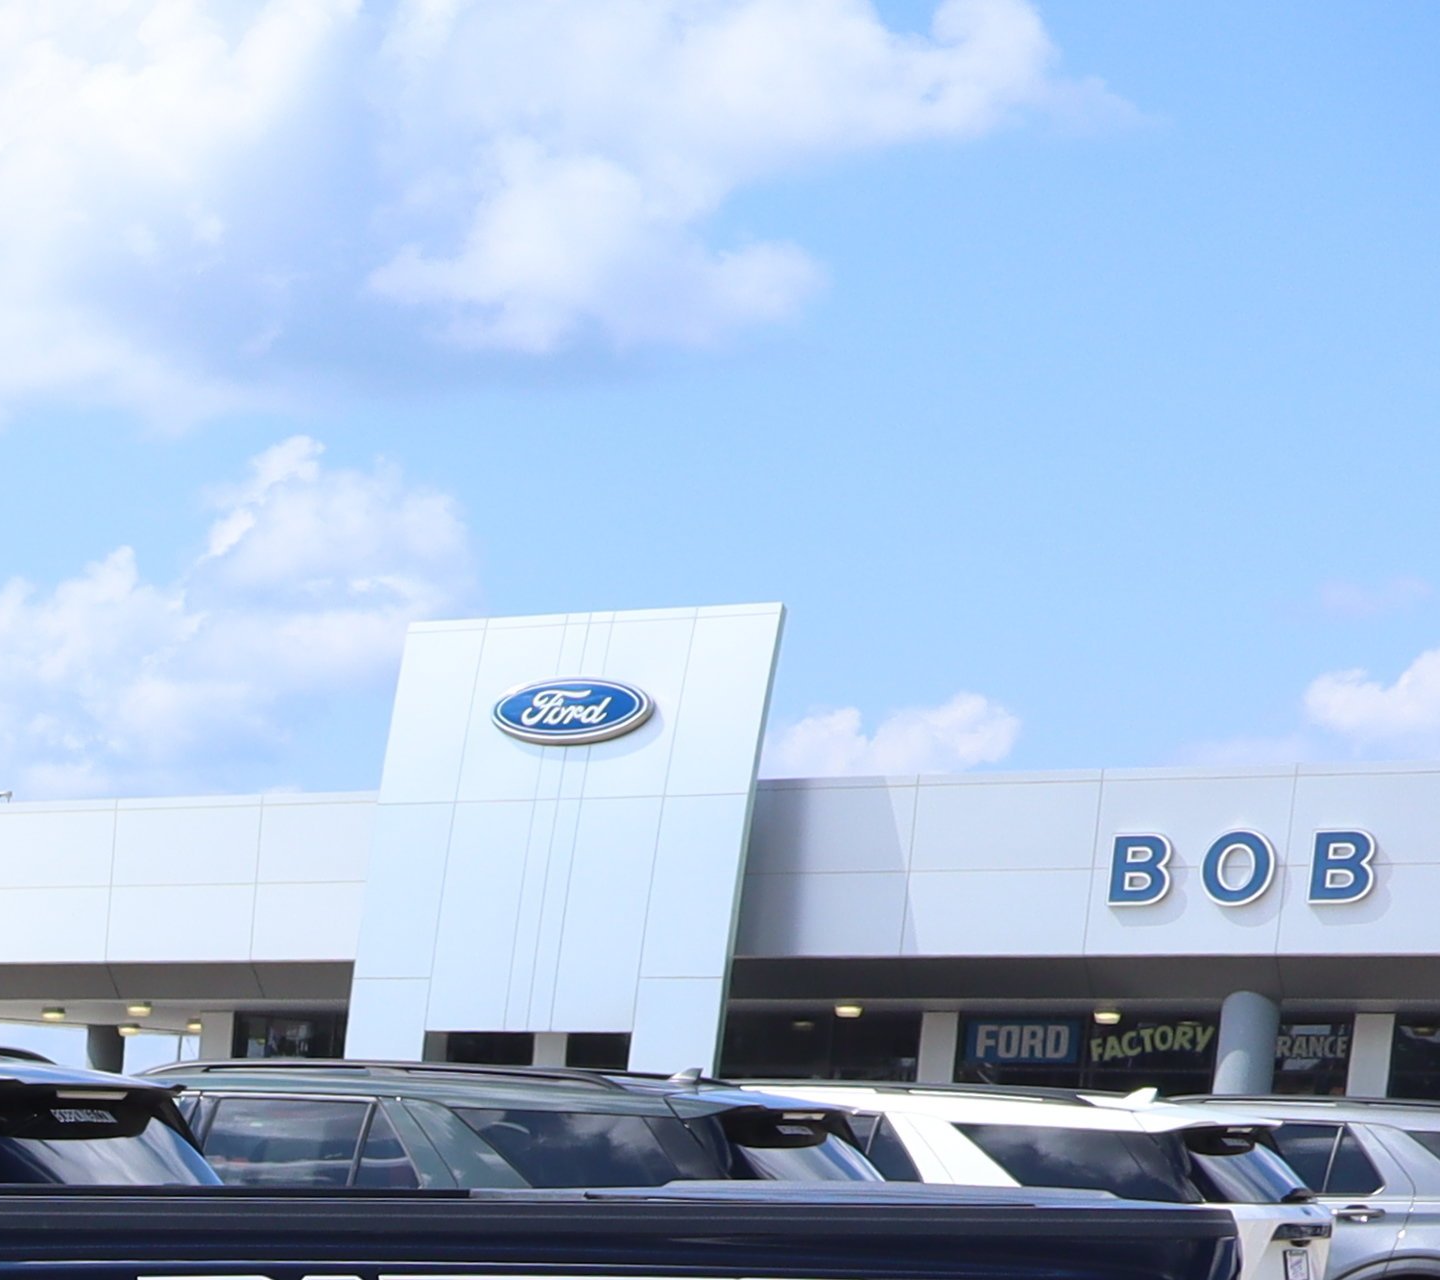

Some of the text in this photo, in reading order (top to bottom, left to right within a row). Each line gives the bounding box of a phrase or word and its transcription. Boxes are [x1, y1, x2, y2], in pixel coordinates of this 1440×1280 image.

[521, 689, 612, 726] Ford
[1107, 828, 1377, 907] BOB
[975, 1024, 1070, 1060] FORD
[1090, 1024, 1215, 1063] FACTORY
[1276, 1034, 1349, 1060] RANCE
